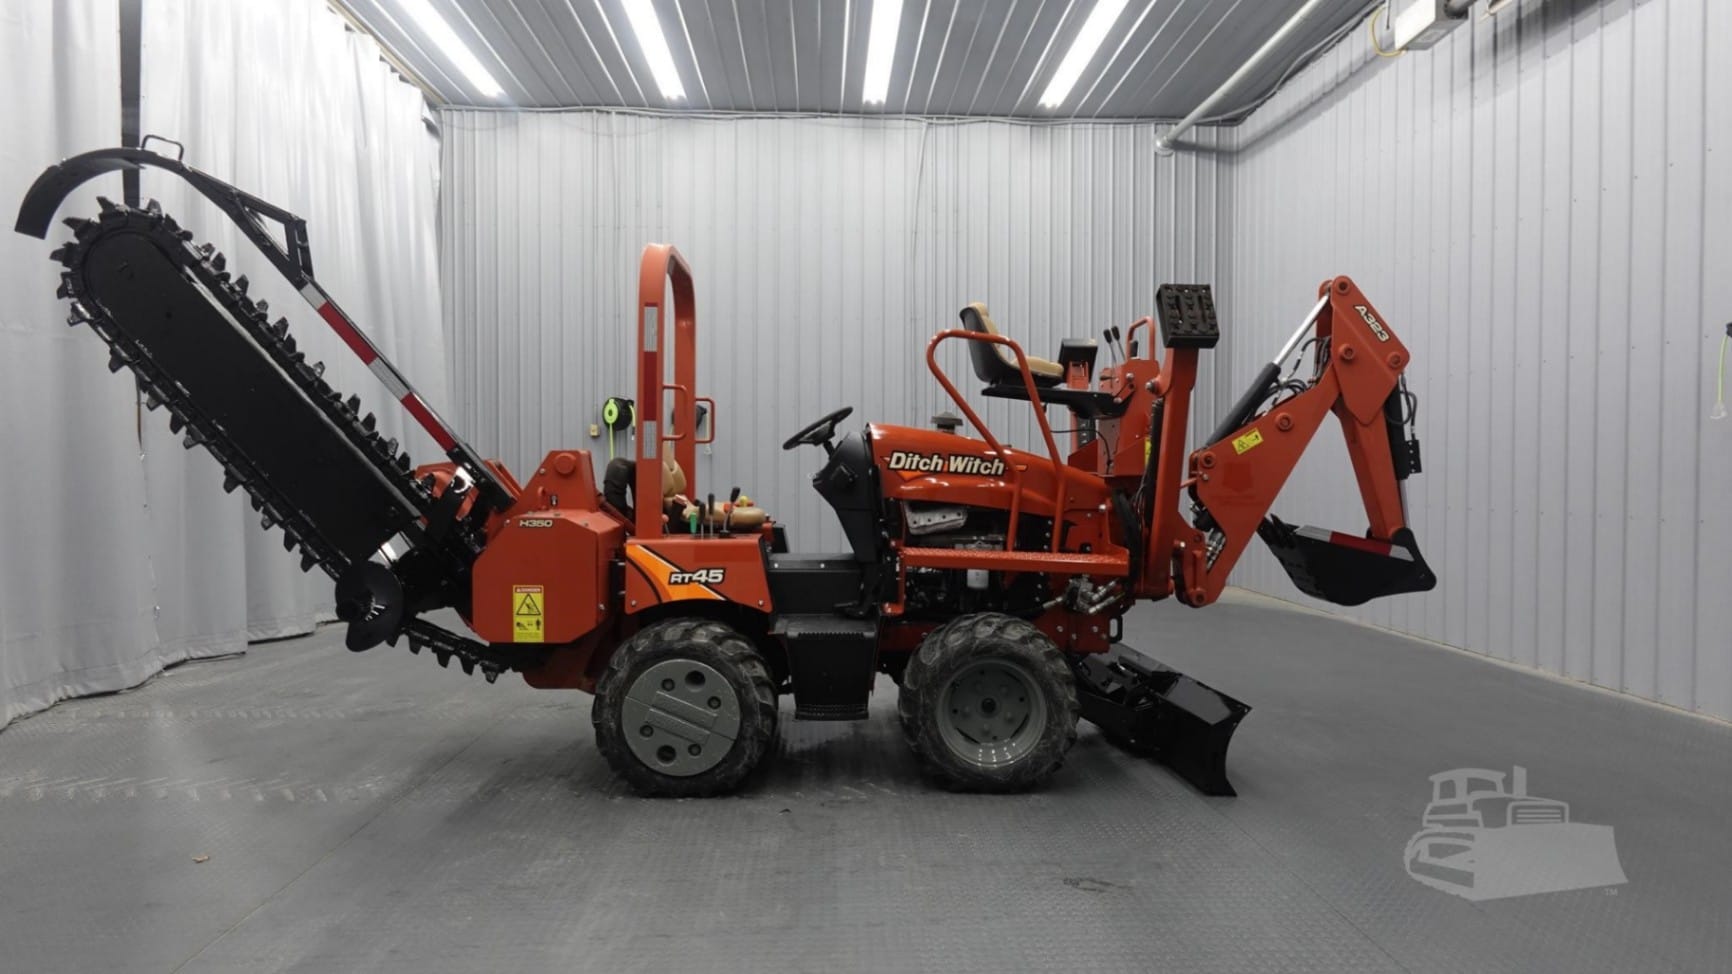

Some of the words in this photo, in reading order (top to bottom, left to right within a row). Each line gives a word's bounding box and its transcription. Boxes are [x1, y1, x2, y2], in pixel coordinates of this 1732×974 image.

[1354, 305, 1390, 342] A323
[889, 451, 943, 472] Ditch
[949, 455, 1005, 476] Witch
[519, 519, 553, 528] H350
[670, 569, 724, 584] RT45
